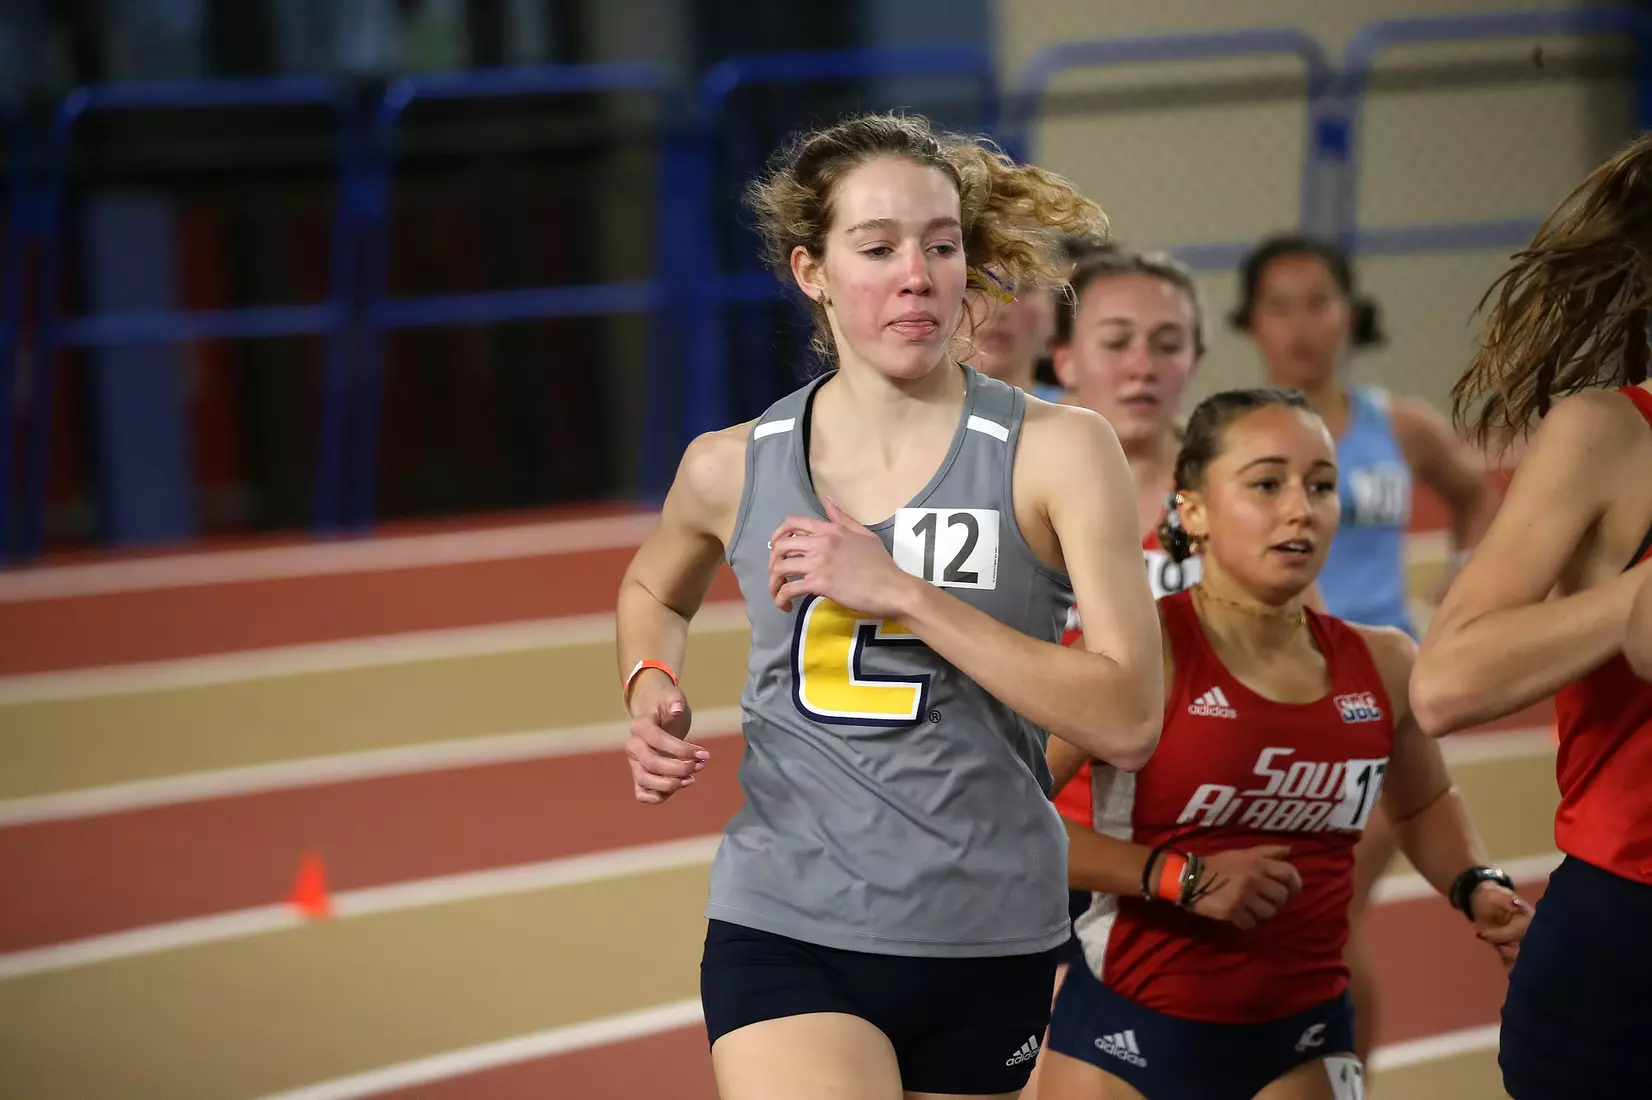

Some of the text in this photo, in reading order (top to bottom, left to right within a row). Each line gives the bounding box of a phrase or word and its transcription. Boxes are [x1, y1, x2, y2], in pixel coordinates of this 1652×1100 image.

[911, 512, 980, 584] 12
[1188, 703, 1238, 719] adidas
[1094, 1037, 1148, 1068] adidas
